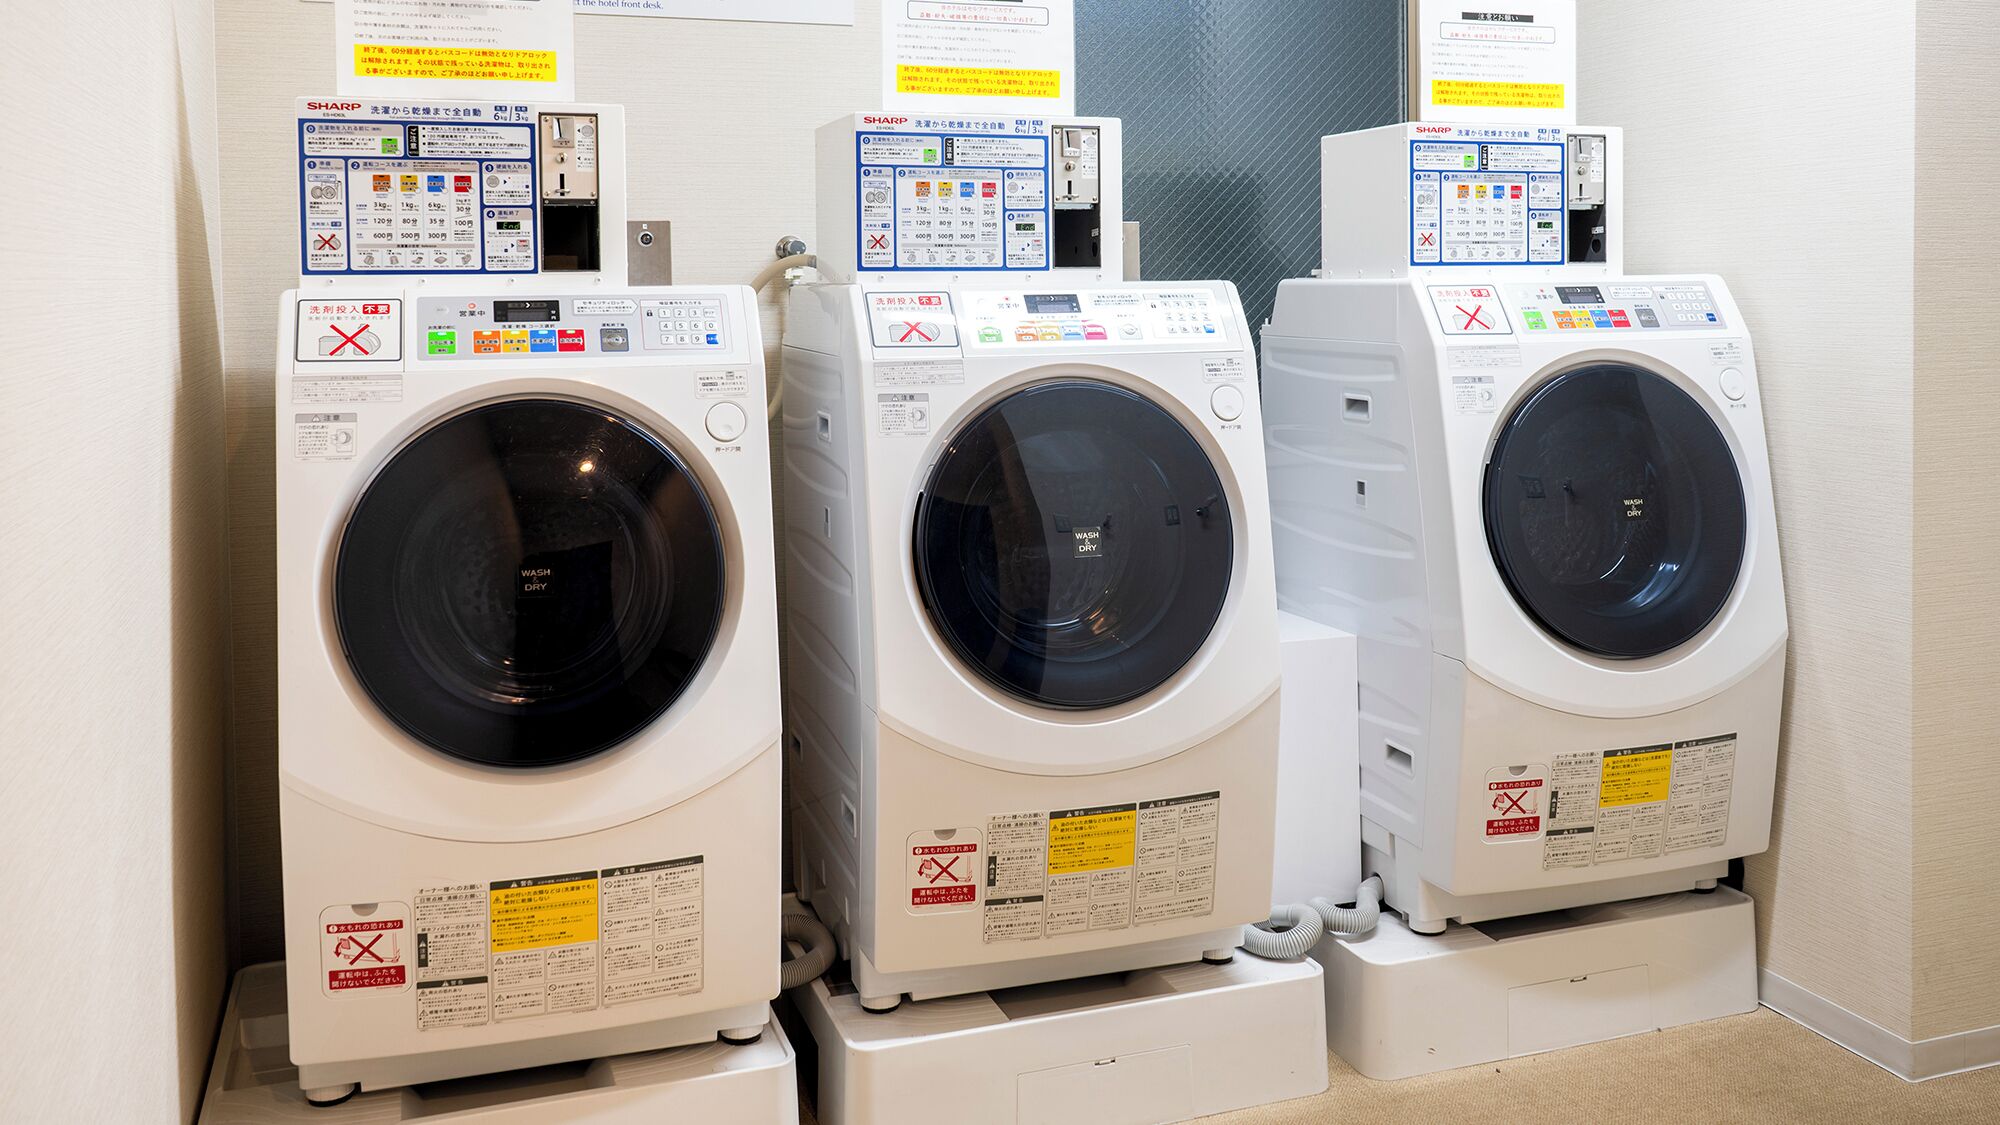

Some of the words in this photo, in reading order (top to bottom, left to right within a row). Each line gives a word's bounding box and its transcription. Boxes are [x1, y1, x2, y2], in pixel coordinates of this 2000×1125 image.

[621, 0, 640, 8] front
[643, 1, 663, 9] desk.
[307, 102, 361, 110] SHARP
[371, 105, 482, 117] 洗濯から乾燥まで全自動
[915, 119, 1005, 130] 洗濯から乾燥まで全自動
[1458, 129, 1530, 138] 洗濯から乾燥まで全自動
[310, 305, 359, 314] 洗剤投入
[364, 305, 388, 313] 不要
[525, 583, 547, 591] DRY
[992, 813, 1044, 821] オーナー様へのお願い
[1488, 826, 1537, 834] 開けないでください。
[419, 884, 482, 894] オーナー様へのお願い
[920, 887, 968, 896] 運転中は、ふたを
[504, 896, 549, 905] 絶対に乾燥しない
[914, 894, 973, 904] 開けないでください。
[339, 922, 400, 931] 水もれの恐れあり
[338, 969, 396, 979] 運転中は、ふたを
[332, 977, 402, 987] 開けないでください。
